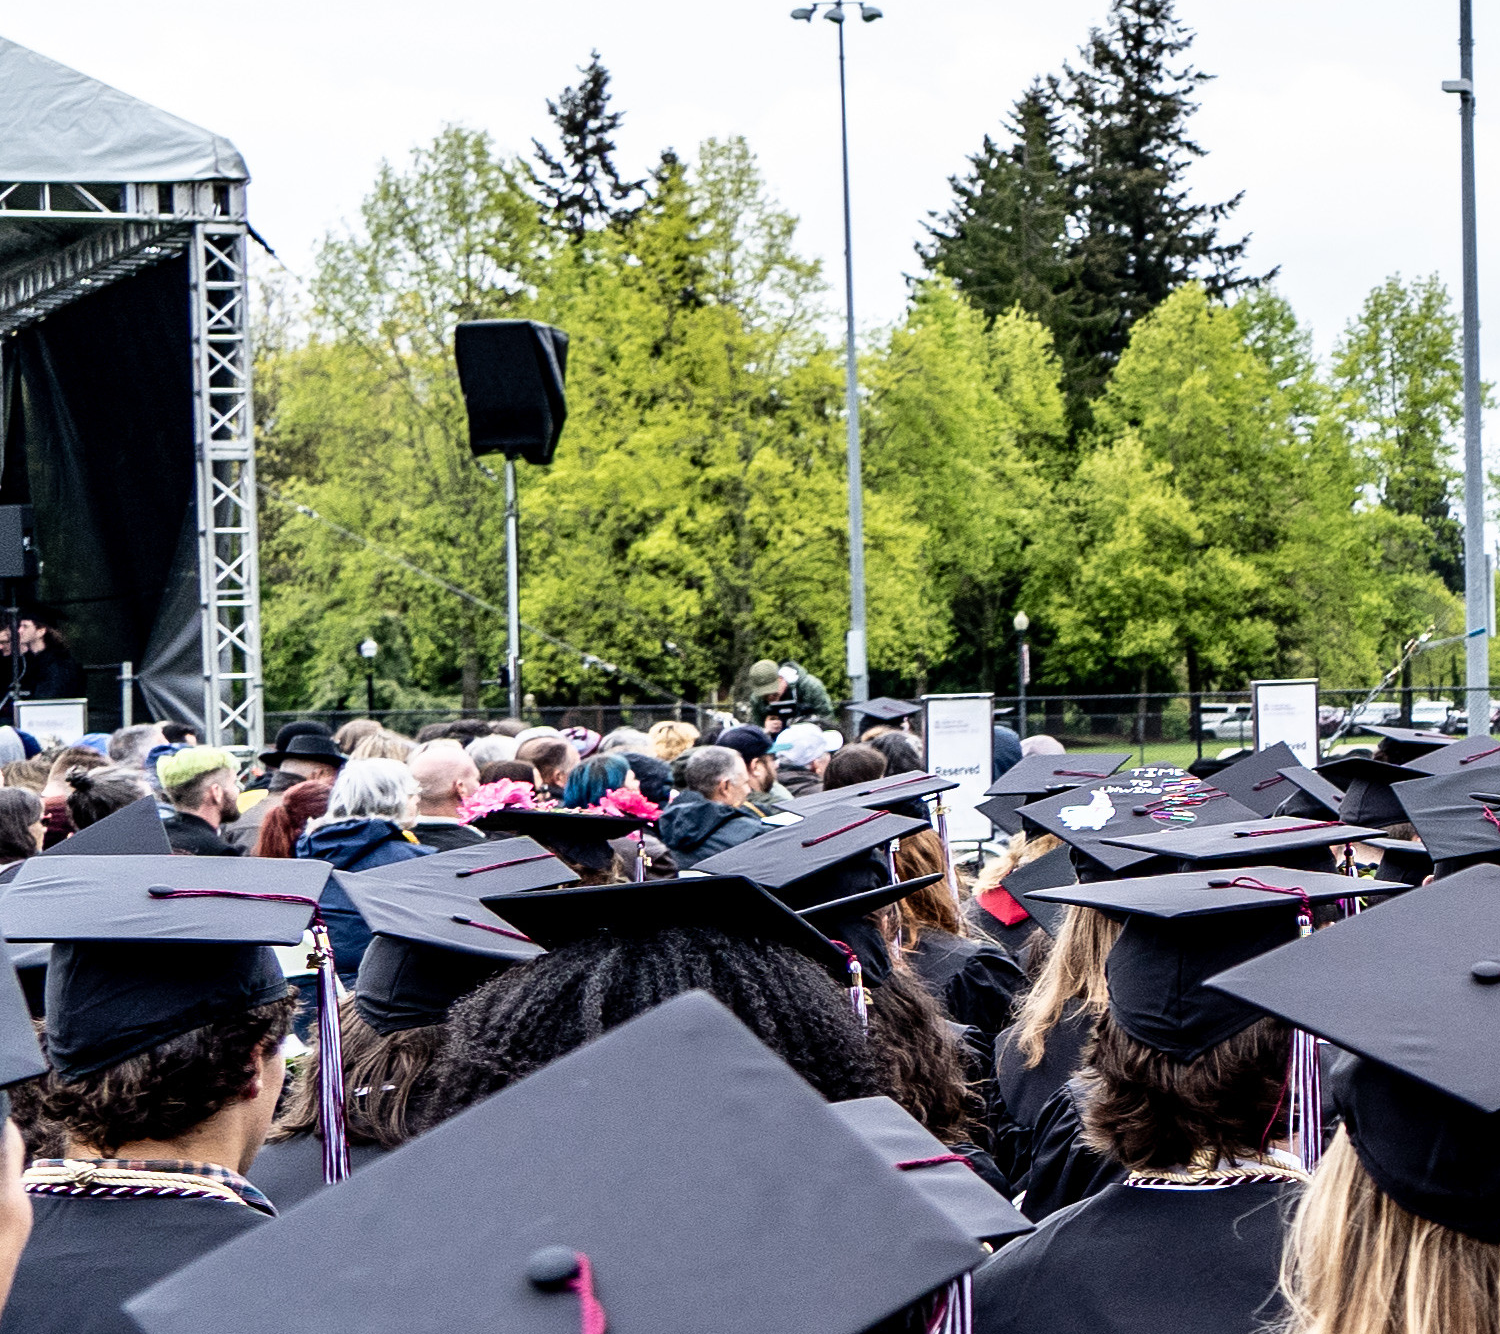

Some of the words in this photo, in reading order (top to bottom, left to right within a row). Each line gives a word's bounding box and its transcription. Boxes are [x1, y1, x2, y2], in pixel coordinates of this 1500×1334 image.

[935, 763, 980, 777] Reserved
[1131, 768, 1184, 778] TIME
[1129, 779, 1153, 787] TO
[1100, 786, 1162, 794] UNWIND
